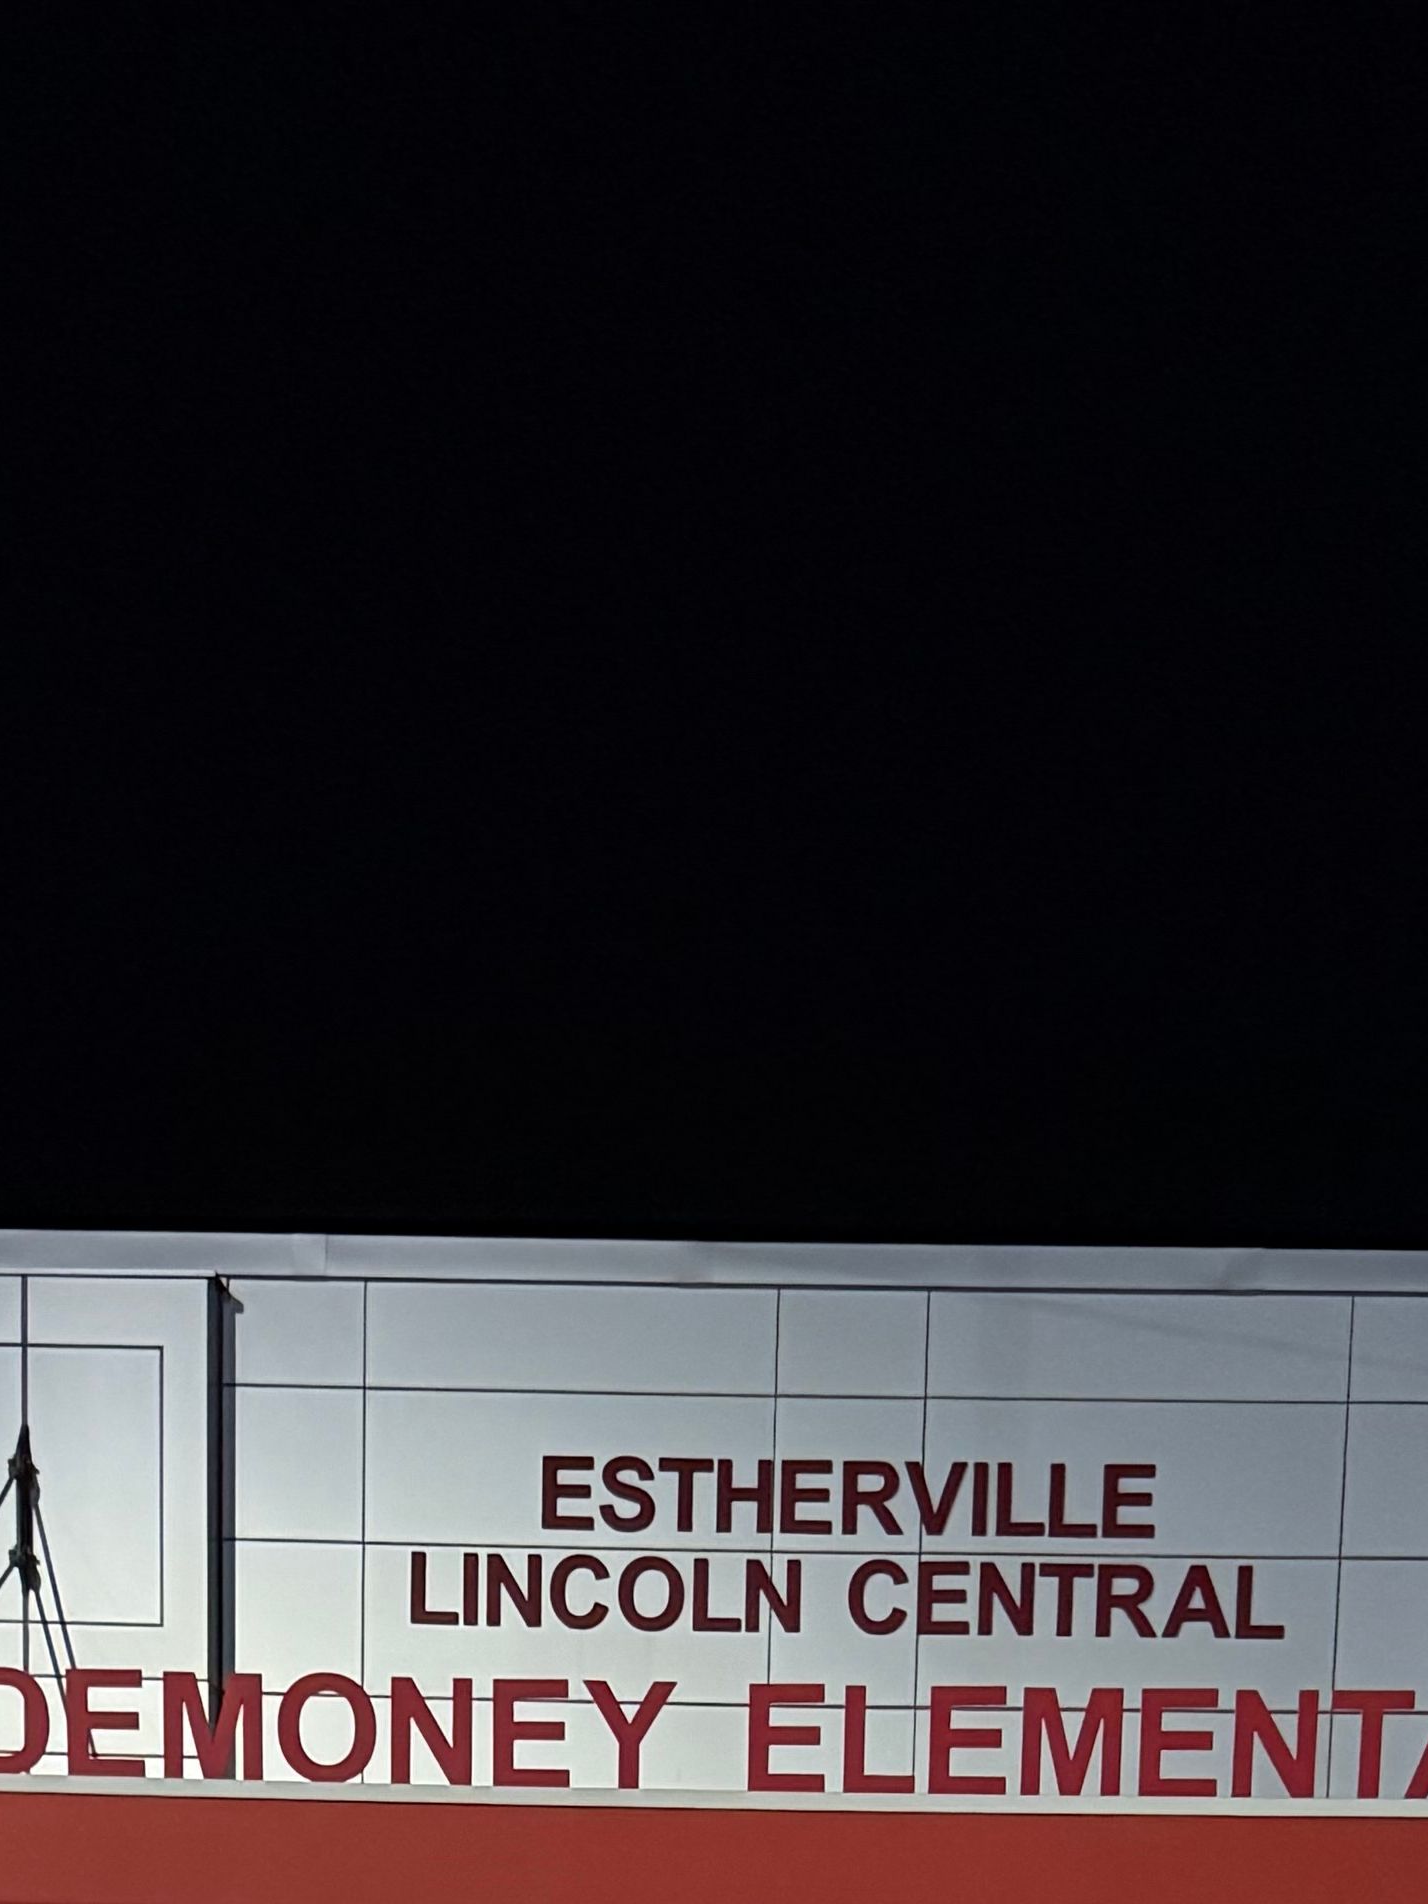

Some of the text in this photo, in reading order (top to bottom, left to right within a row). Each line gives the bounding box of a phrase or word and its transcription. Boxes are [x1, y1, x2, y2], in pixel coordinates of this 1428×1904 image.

[541, 1454, 1156, 1538] ESTHERVILLE
[409, 1550, 1285, 1641] LINCOLN CENTRAL
